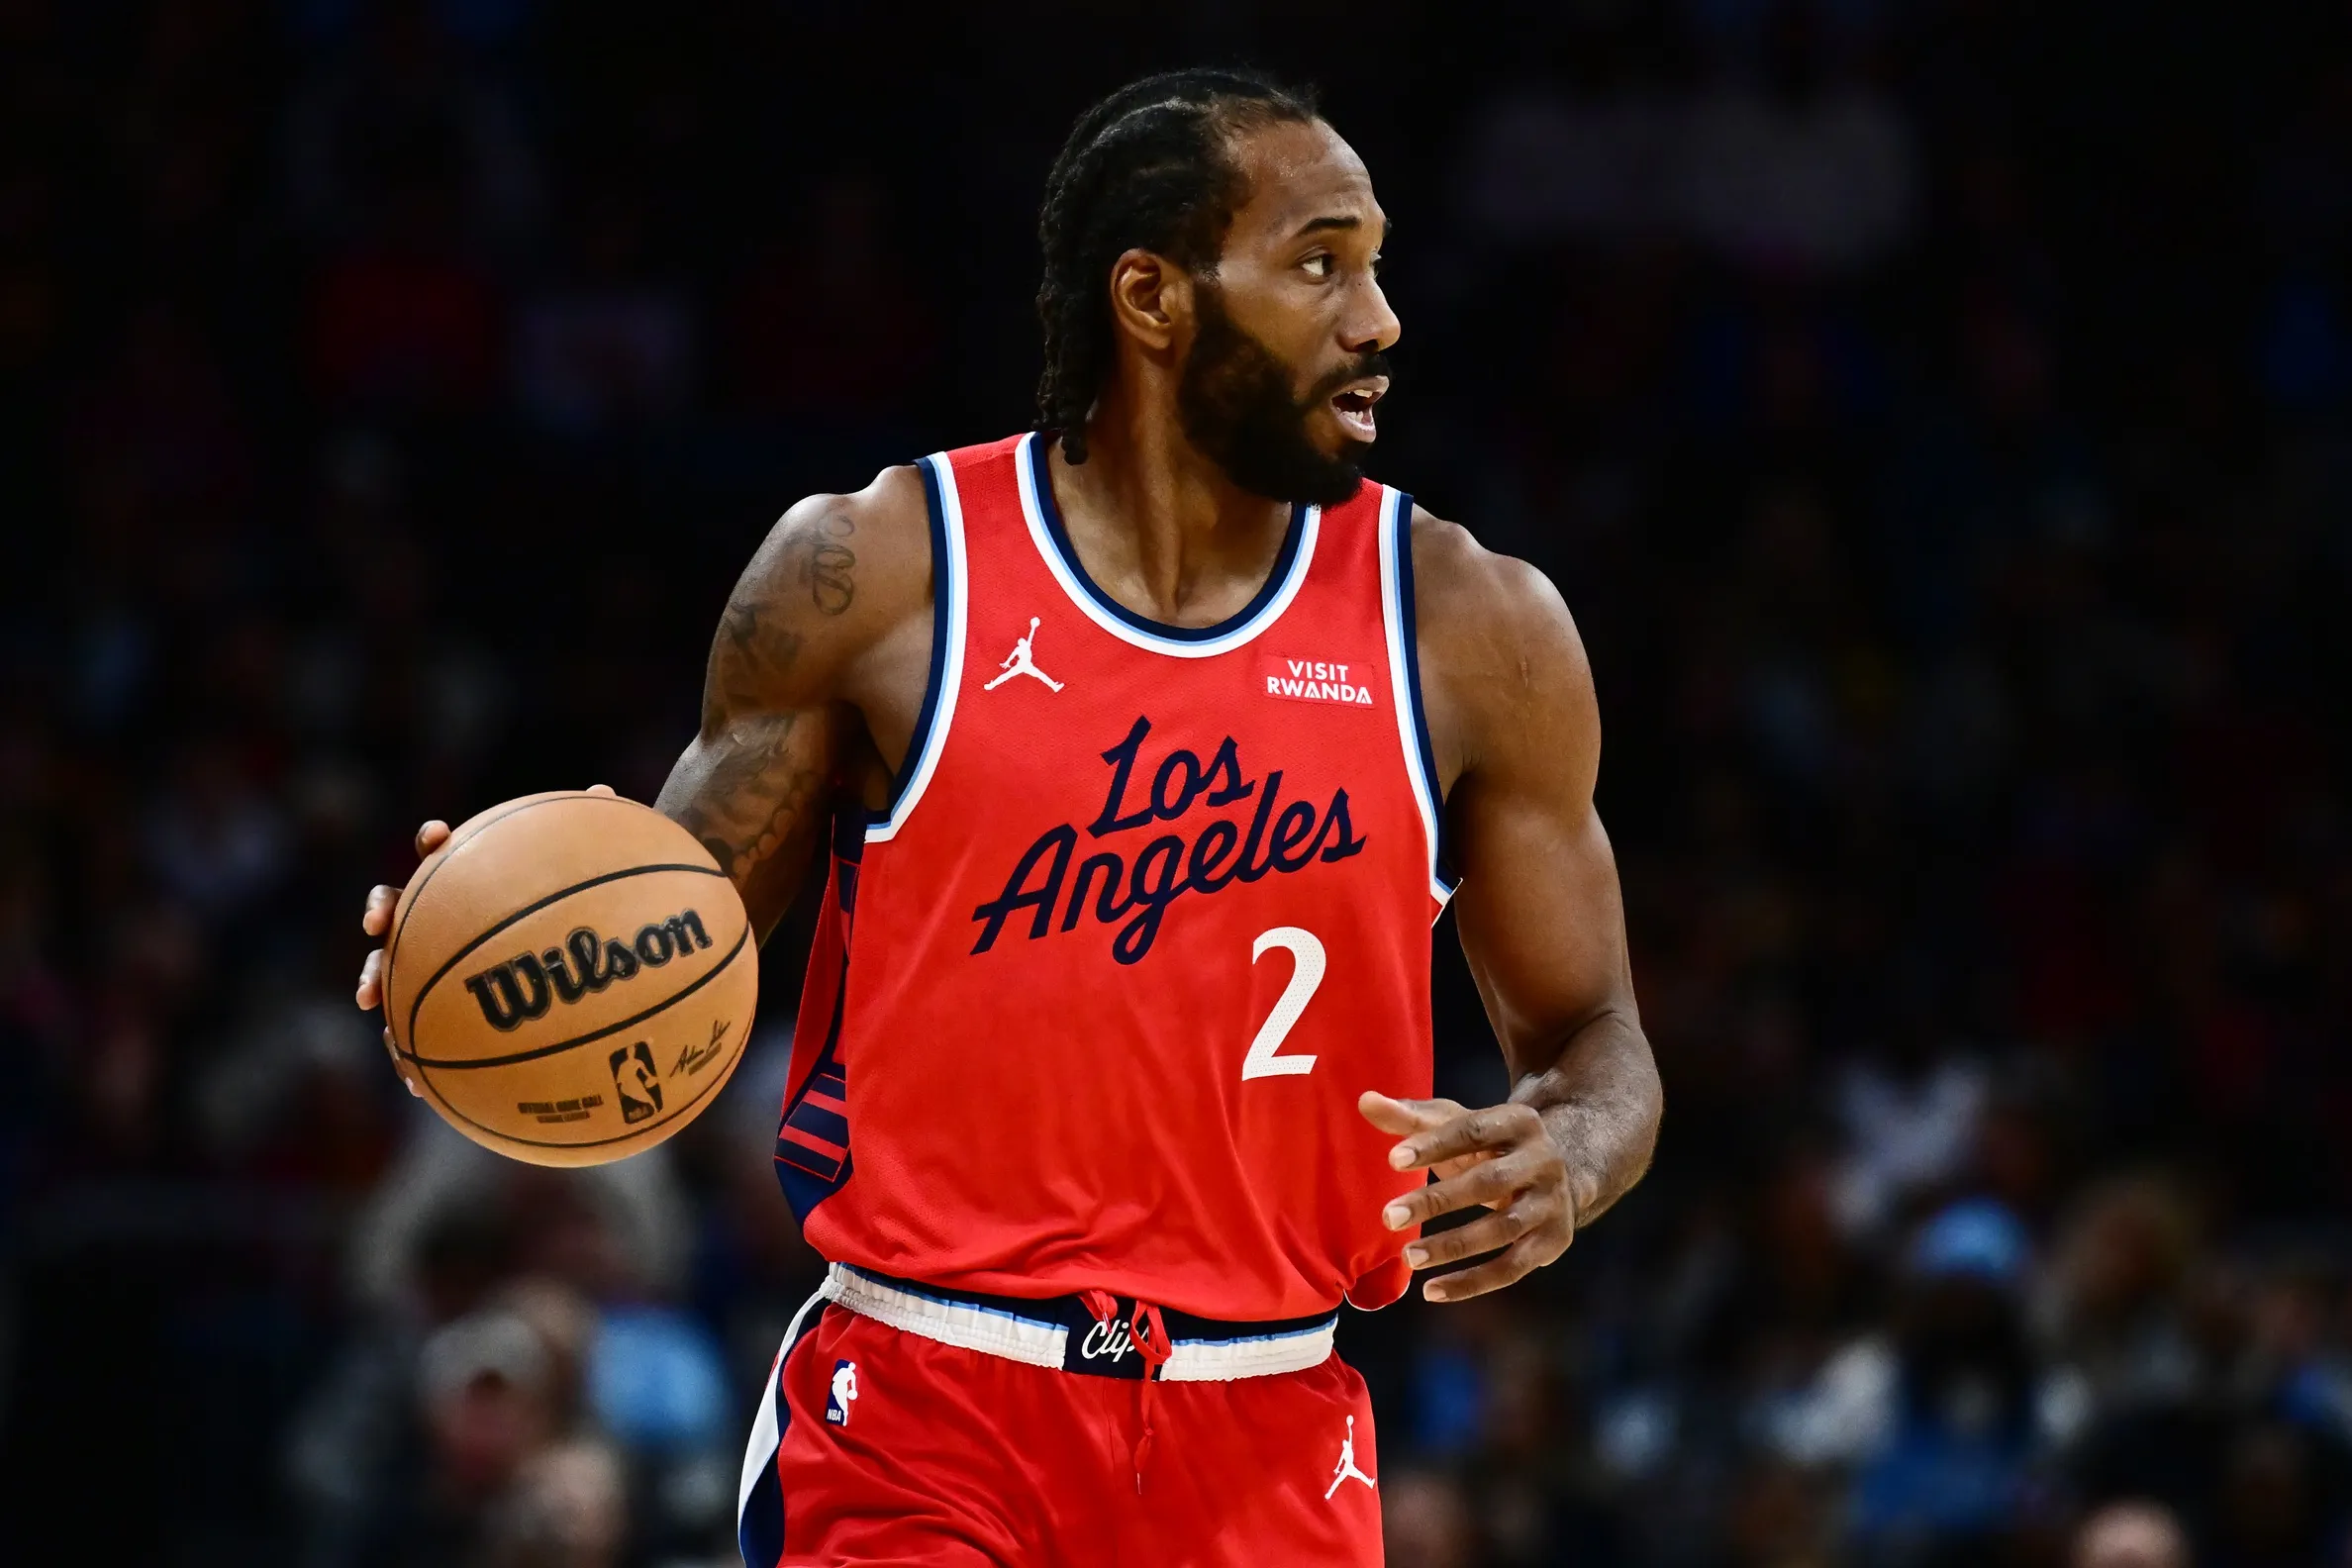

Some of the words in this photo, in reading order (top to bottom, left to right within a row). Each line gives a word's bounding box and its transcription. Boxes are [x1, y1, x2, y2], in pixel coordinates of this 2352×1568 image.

[1266, 676, 1373, 705] RWANDA
[1287, 660, 1349, 682] VISIT
[1086, 715, 1256, 838] Los
[969, 770, 1367, 966] Angeles
[464, 908, 714, 1032] Wilson
[1241, 926, 1327, 1082] 2
[1081, 1319, 1149, 1362] Clip
[826, 1409, 841, 1422] NBA
